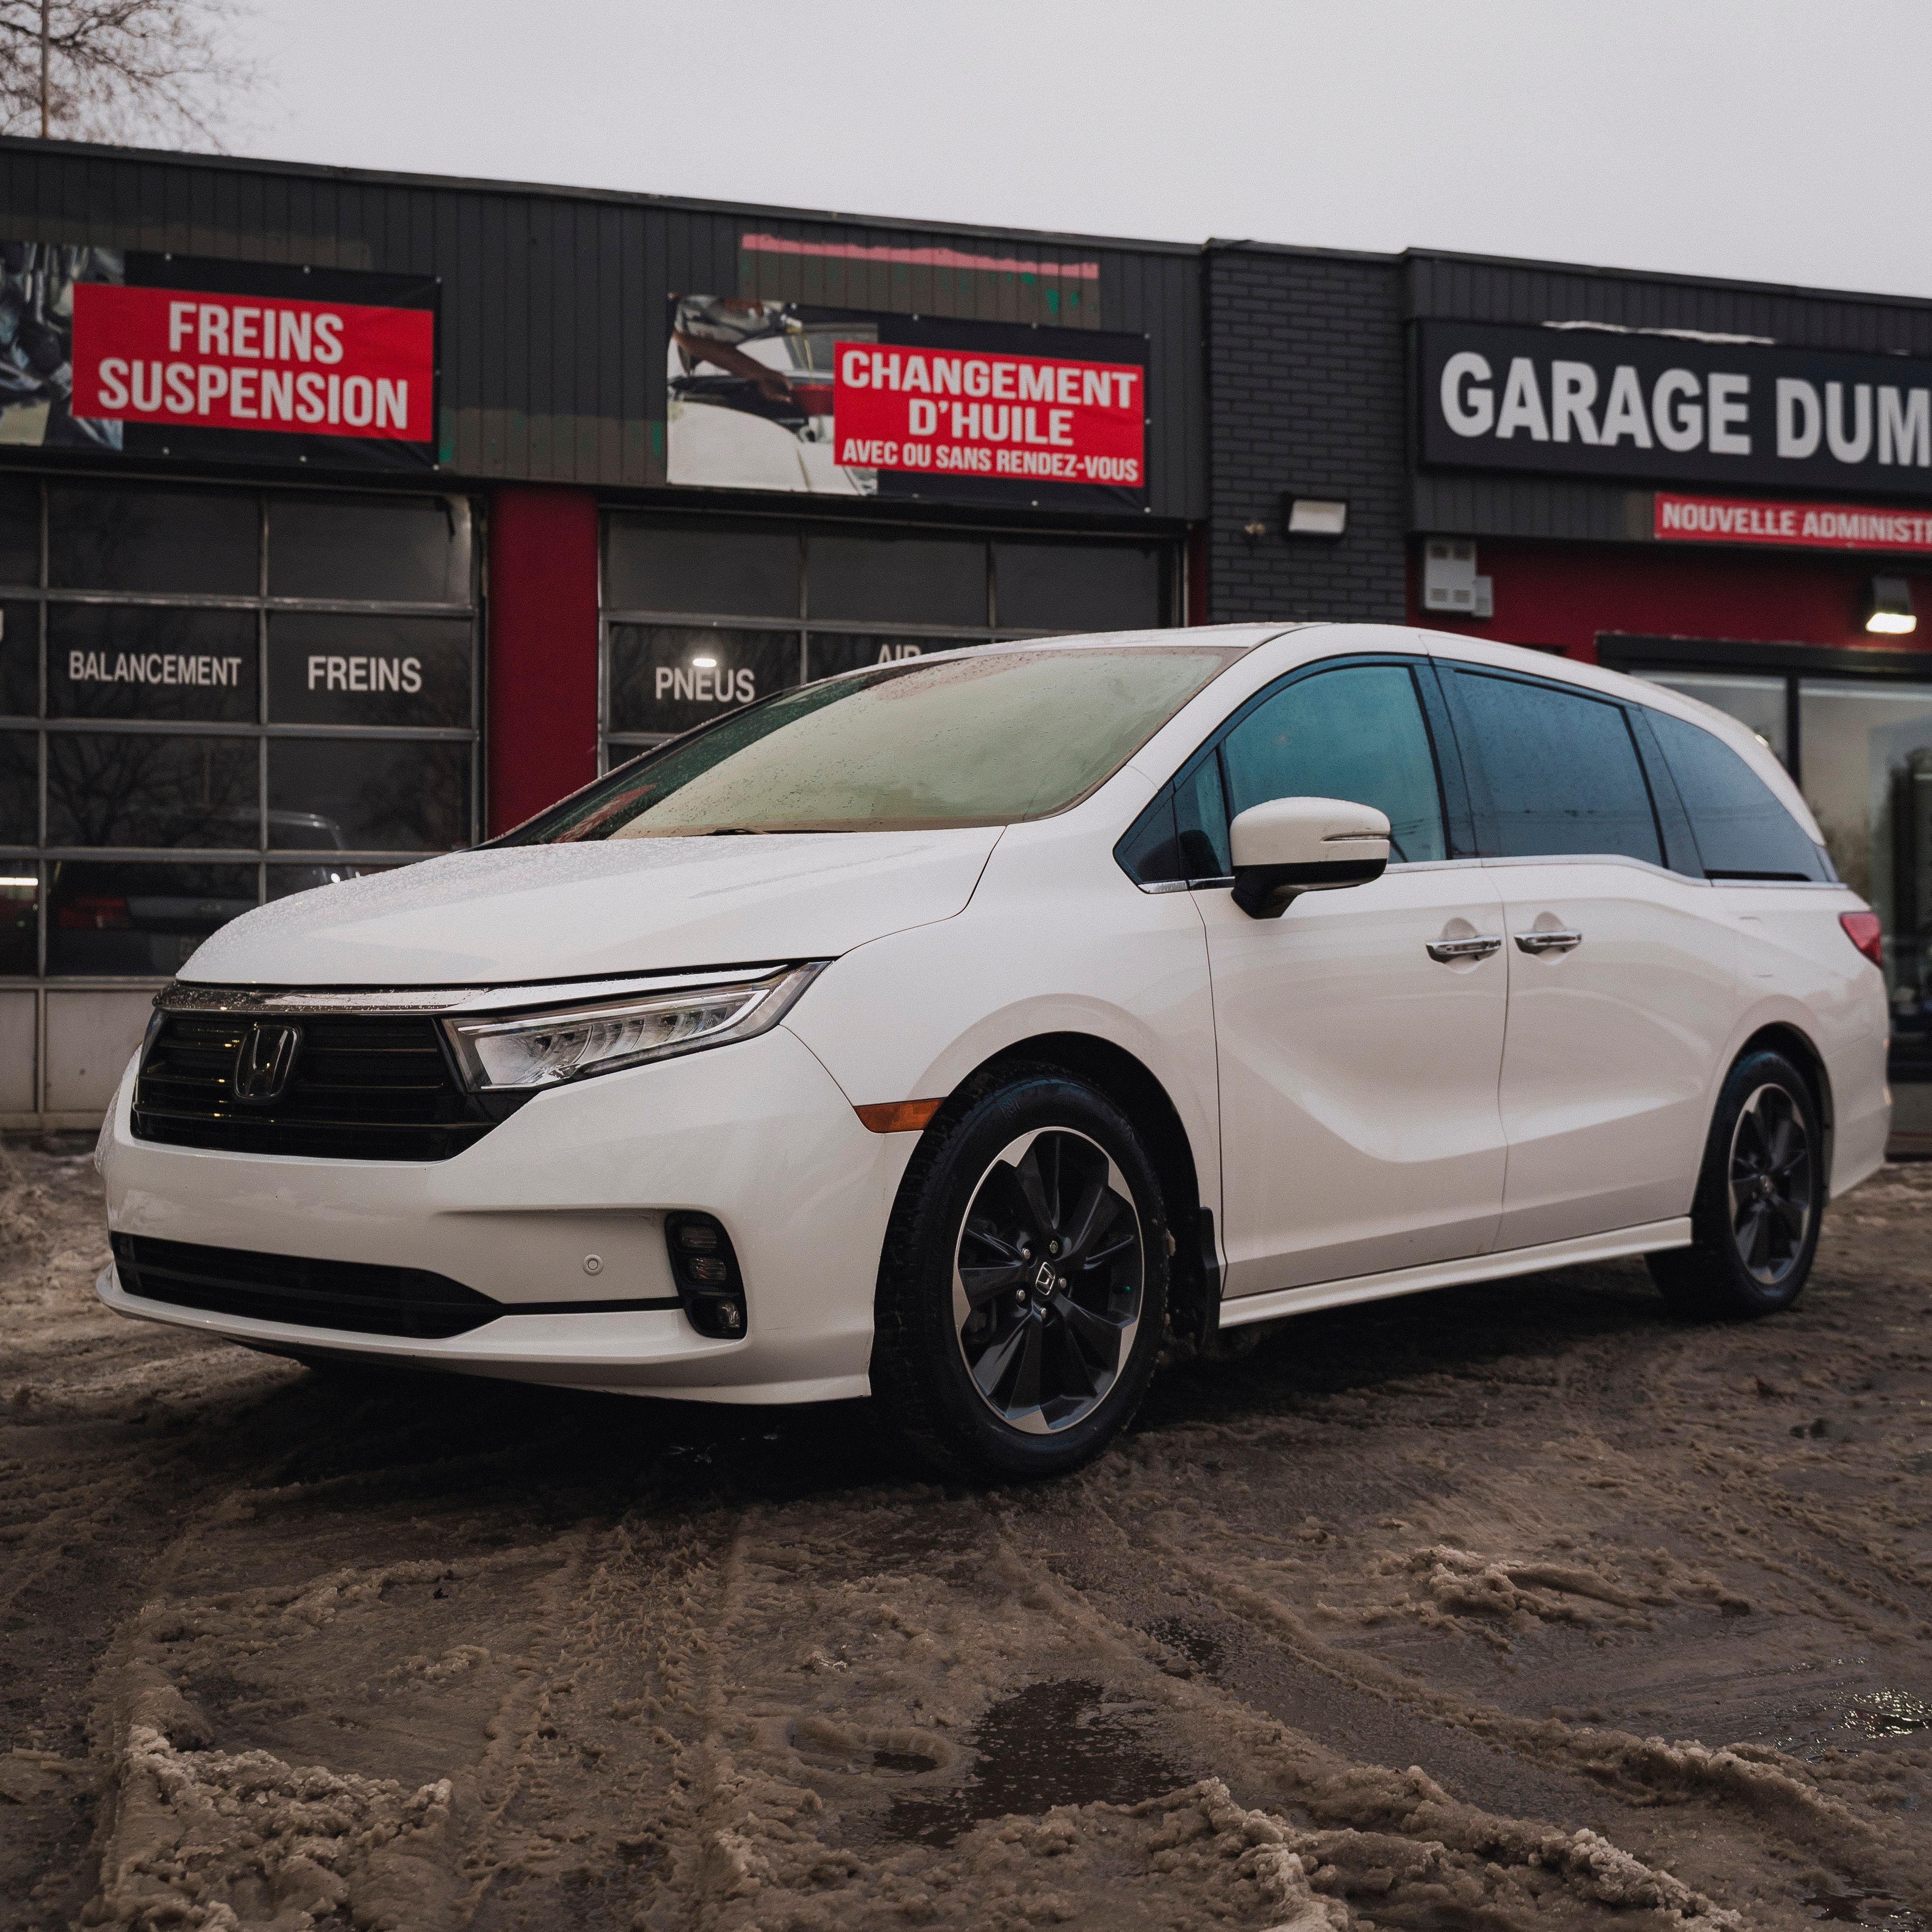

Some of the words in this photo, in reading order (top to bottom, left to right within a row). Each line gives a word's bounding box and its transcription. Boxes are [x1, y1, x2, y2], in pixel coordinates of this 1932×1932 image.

[169, 301, 344, 364] FREINS
[98, 358, 408, 429] SUSPENSION
[842, 350, 1138, 408] CHANGEMENT
[908, 398, 1074, 447] D'HUILE
[1440, 351, 1751, 455] GARAGE
[1776, 377, 1932, 467] DUM
[842, 438, 899, 465] AVEC
[902, 442, 932, 468] OU
[936, 444, 992, 472] SANS
[996, 449, 1139, 482] RENDEZ-VOUS
[1662, 502, 1796, 537] NOUVELLE
[69, 650, 242, 686] BALANCEMENT
[308, 655, 422, 693] FREINS
[655, 667, 755, 703] PNEUS
